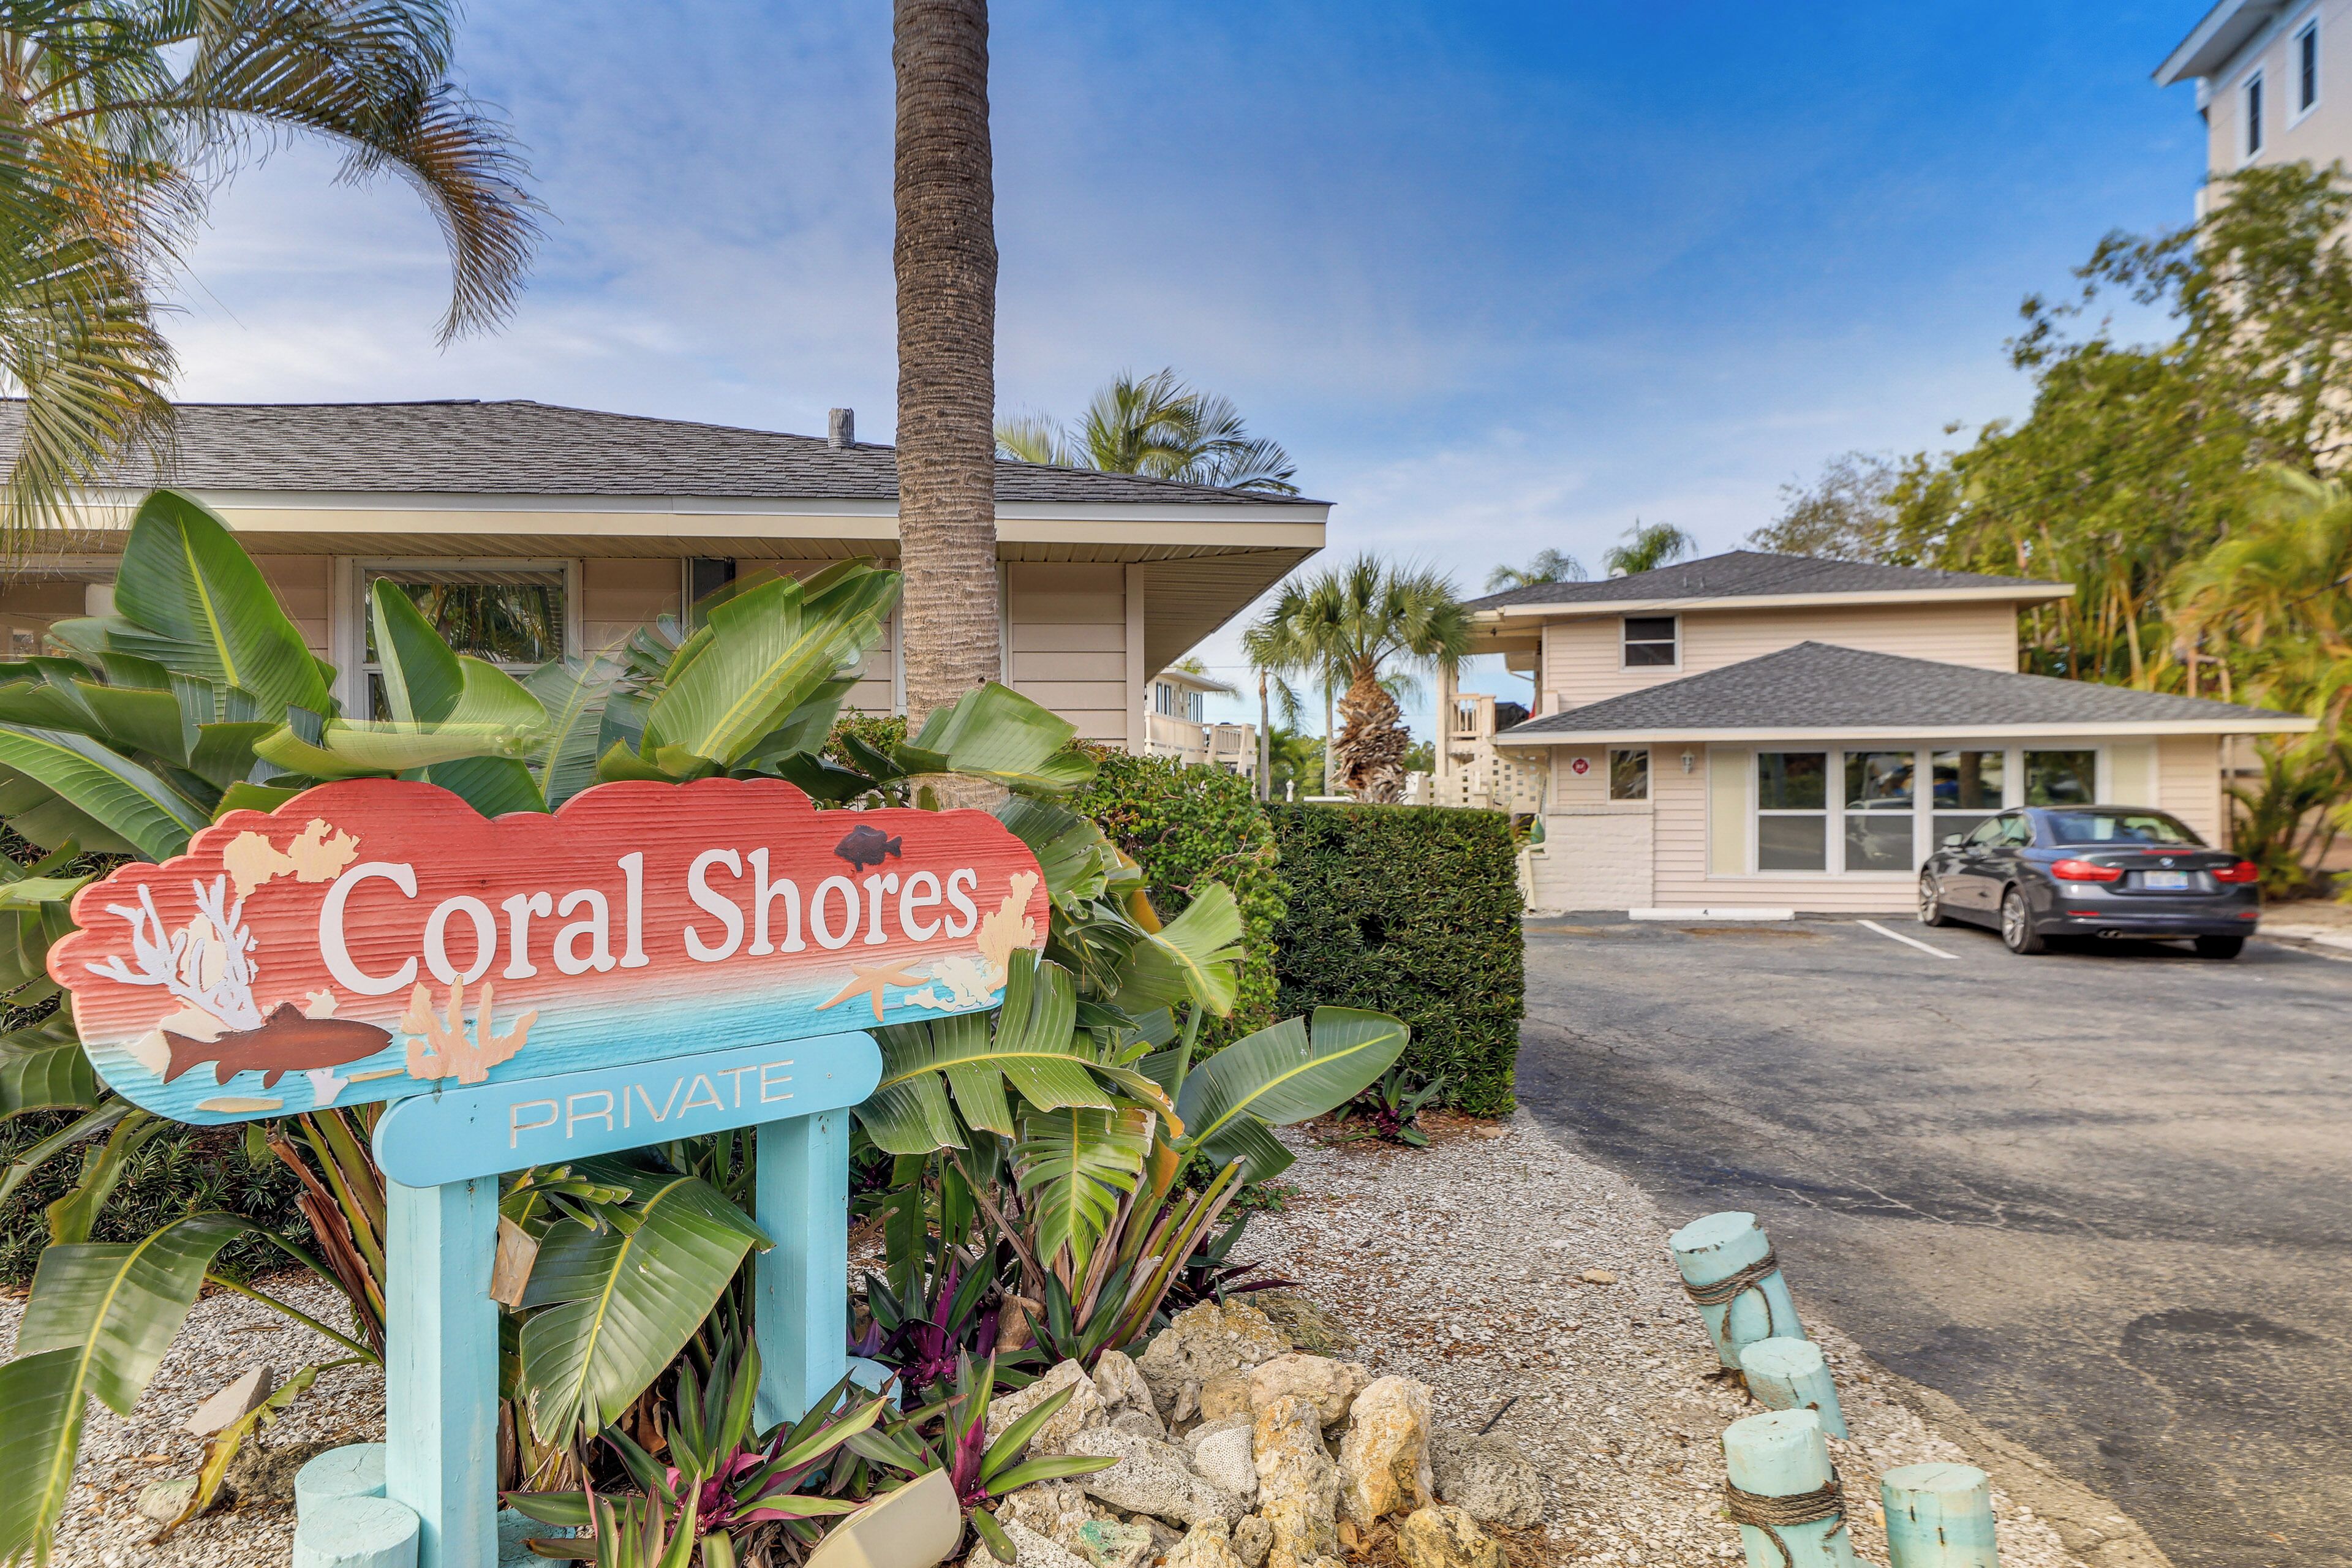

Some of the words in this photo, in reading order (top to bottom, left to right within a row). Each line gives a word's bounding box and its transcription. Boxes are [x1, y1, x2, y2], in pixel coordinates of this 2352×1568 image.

[319, 852, 649, 995] Coral
[684, 848, 978, 962] Shores
[510, 1060, 794, 1149] PRIVATE
